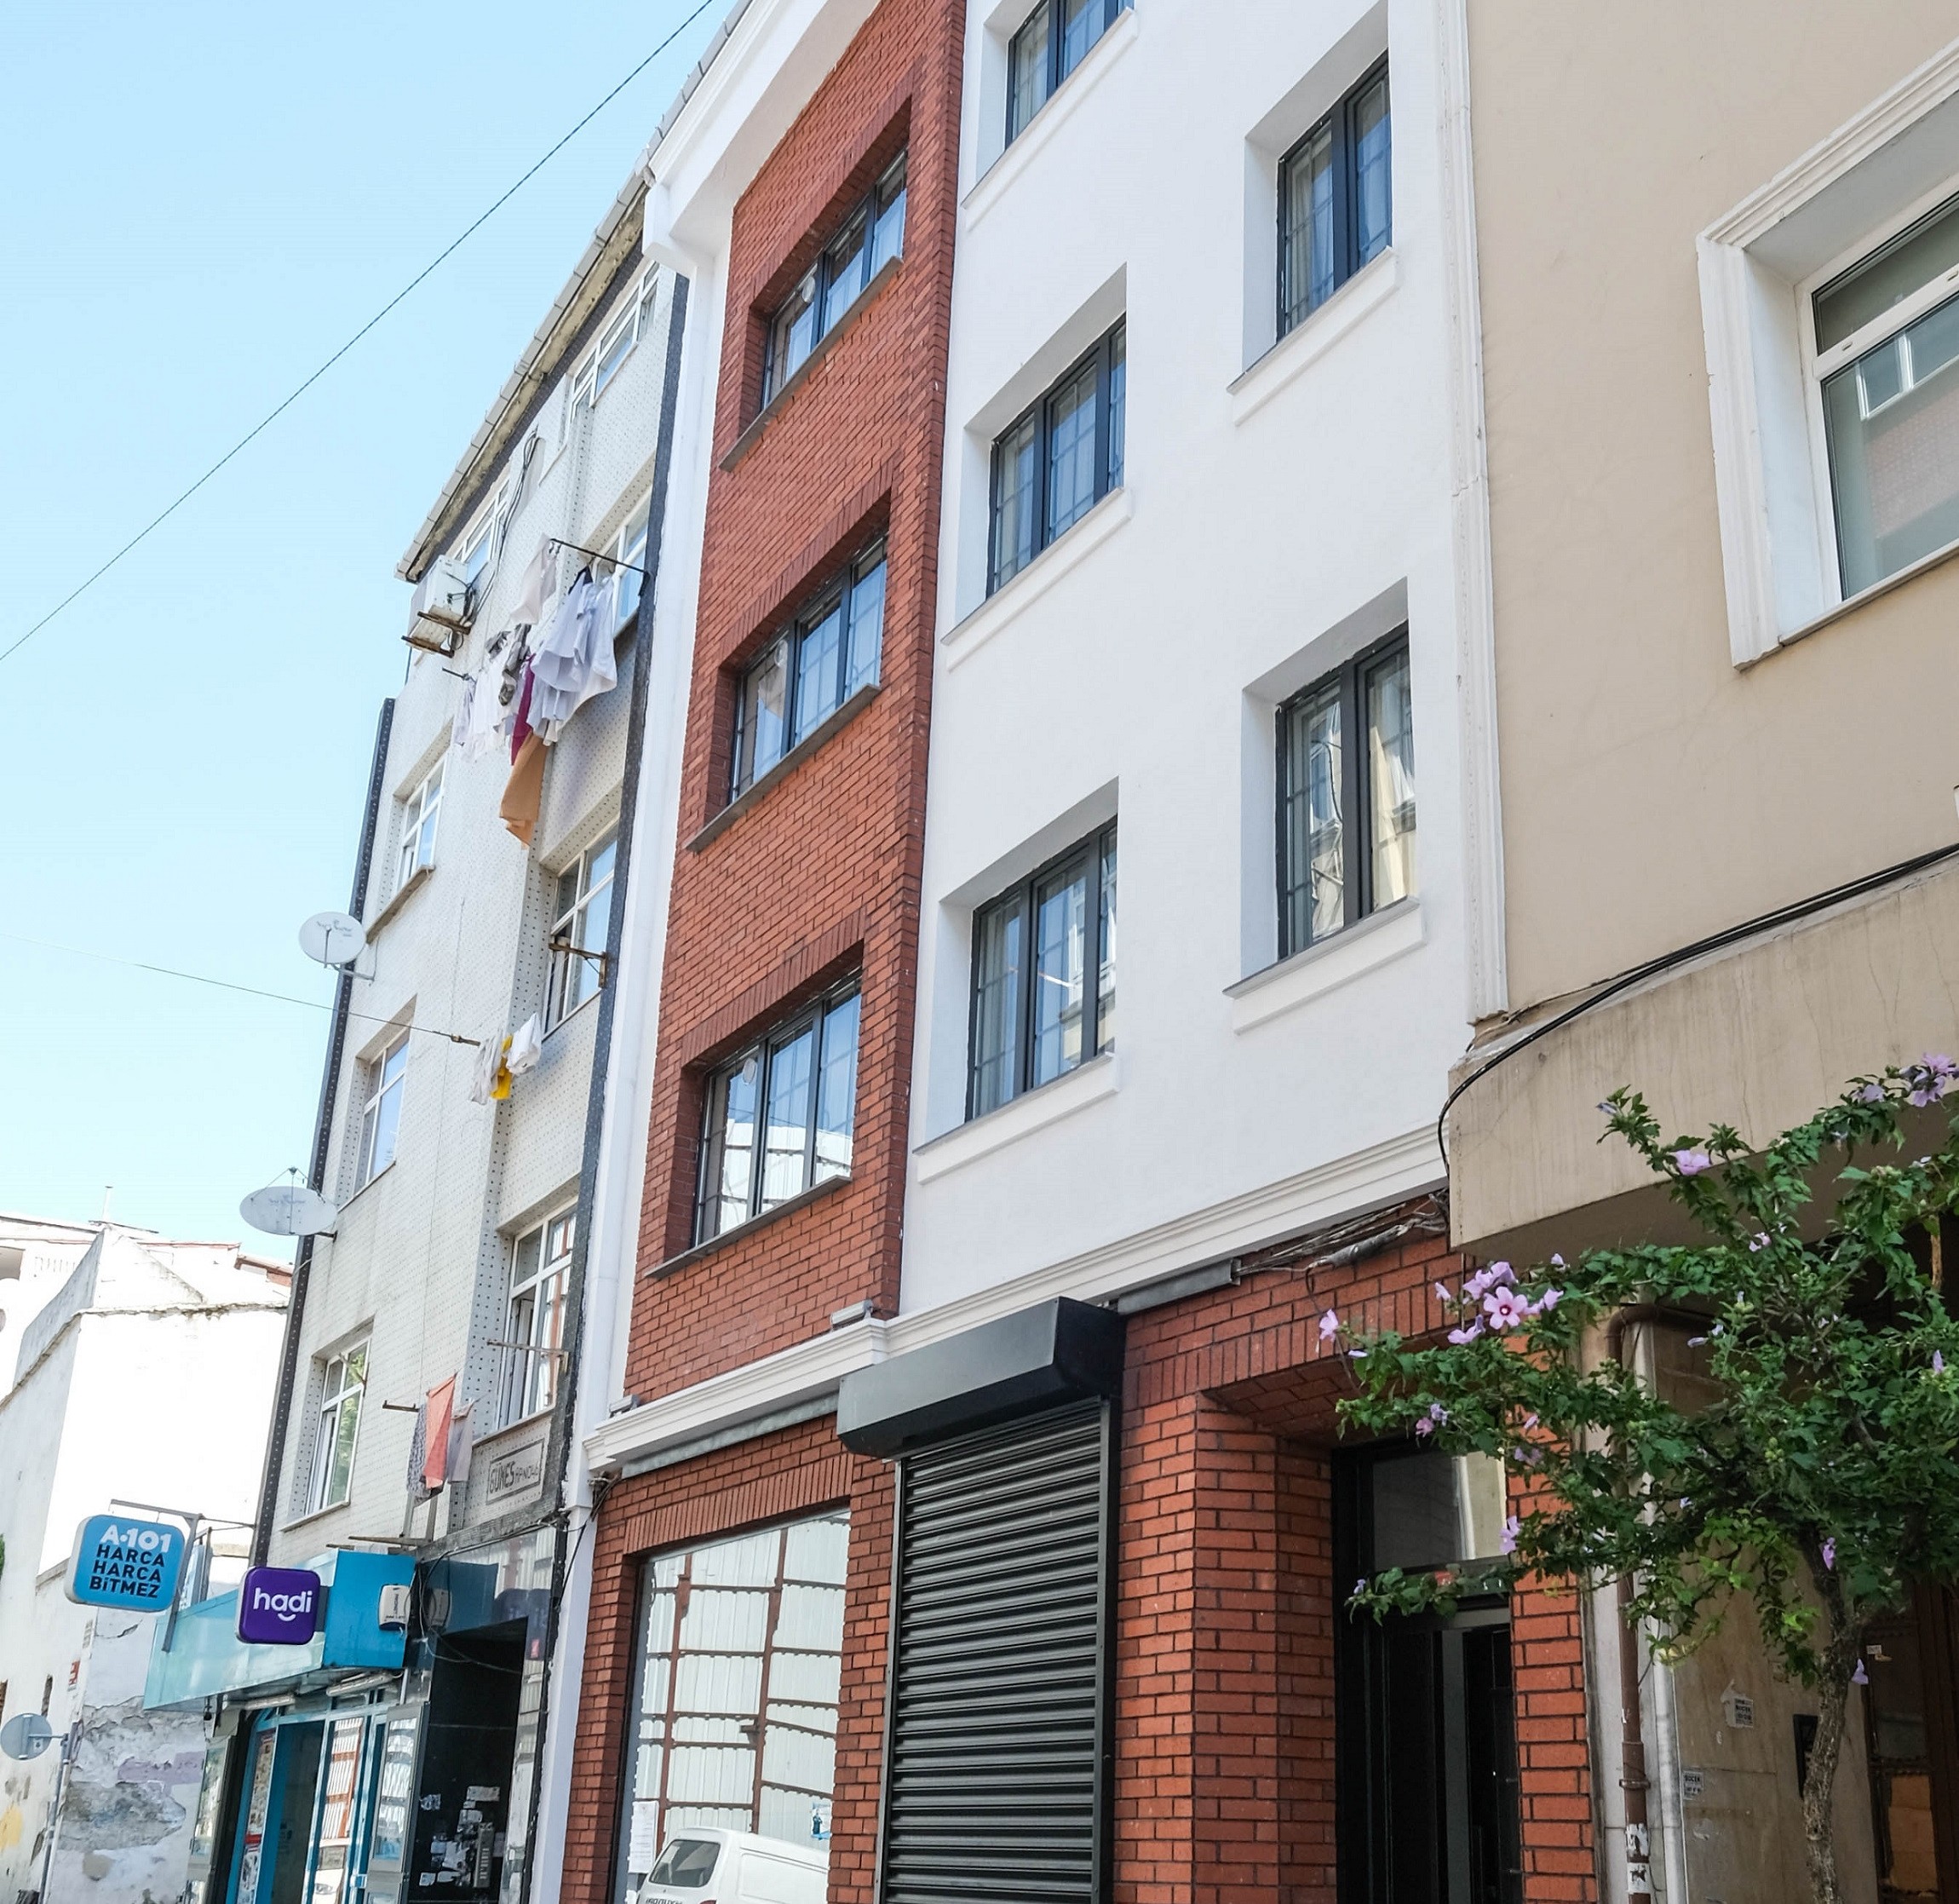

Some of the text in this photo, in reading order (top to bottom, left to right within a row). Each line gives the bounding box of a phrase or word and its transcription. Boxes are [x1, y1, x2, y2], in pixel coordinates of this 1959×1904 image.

[96, 1544, 164, 1567] HARCA
[93, 1560, 161, 1583] HARCA
[253, 1587, 313, 1613] hadi
